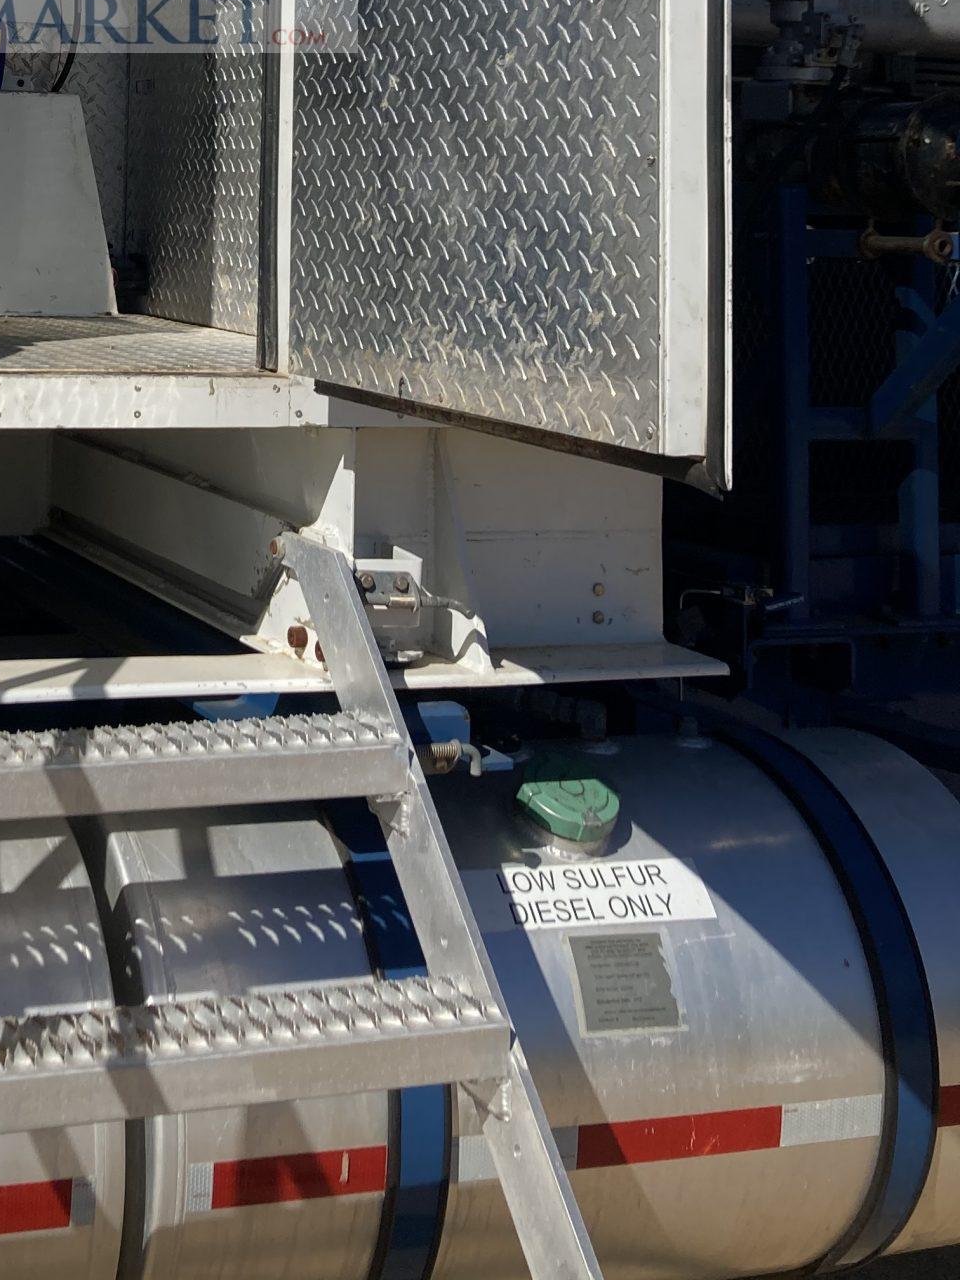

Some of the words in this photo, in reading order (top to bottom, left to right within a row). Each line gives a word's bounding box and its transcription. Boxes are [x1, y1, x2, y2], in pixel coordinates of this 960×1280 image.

[496, 870, 556, 894] LOW
[562, 864, 668, 890] SULFUR
[509, 898, 605, 926] DIESEL
[608, 893, 673, 918] ONLY
